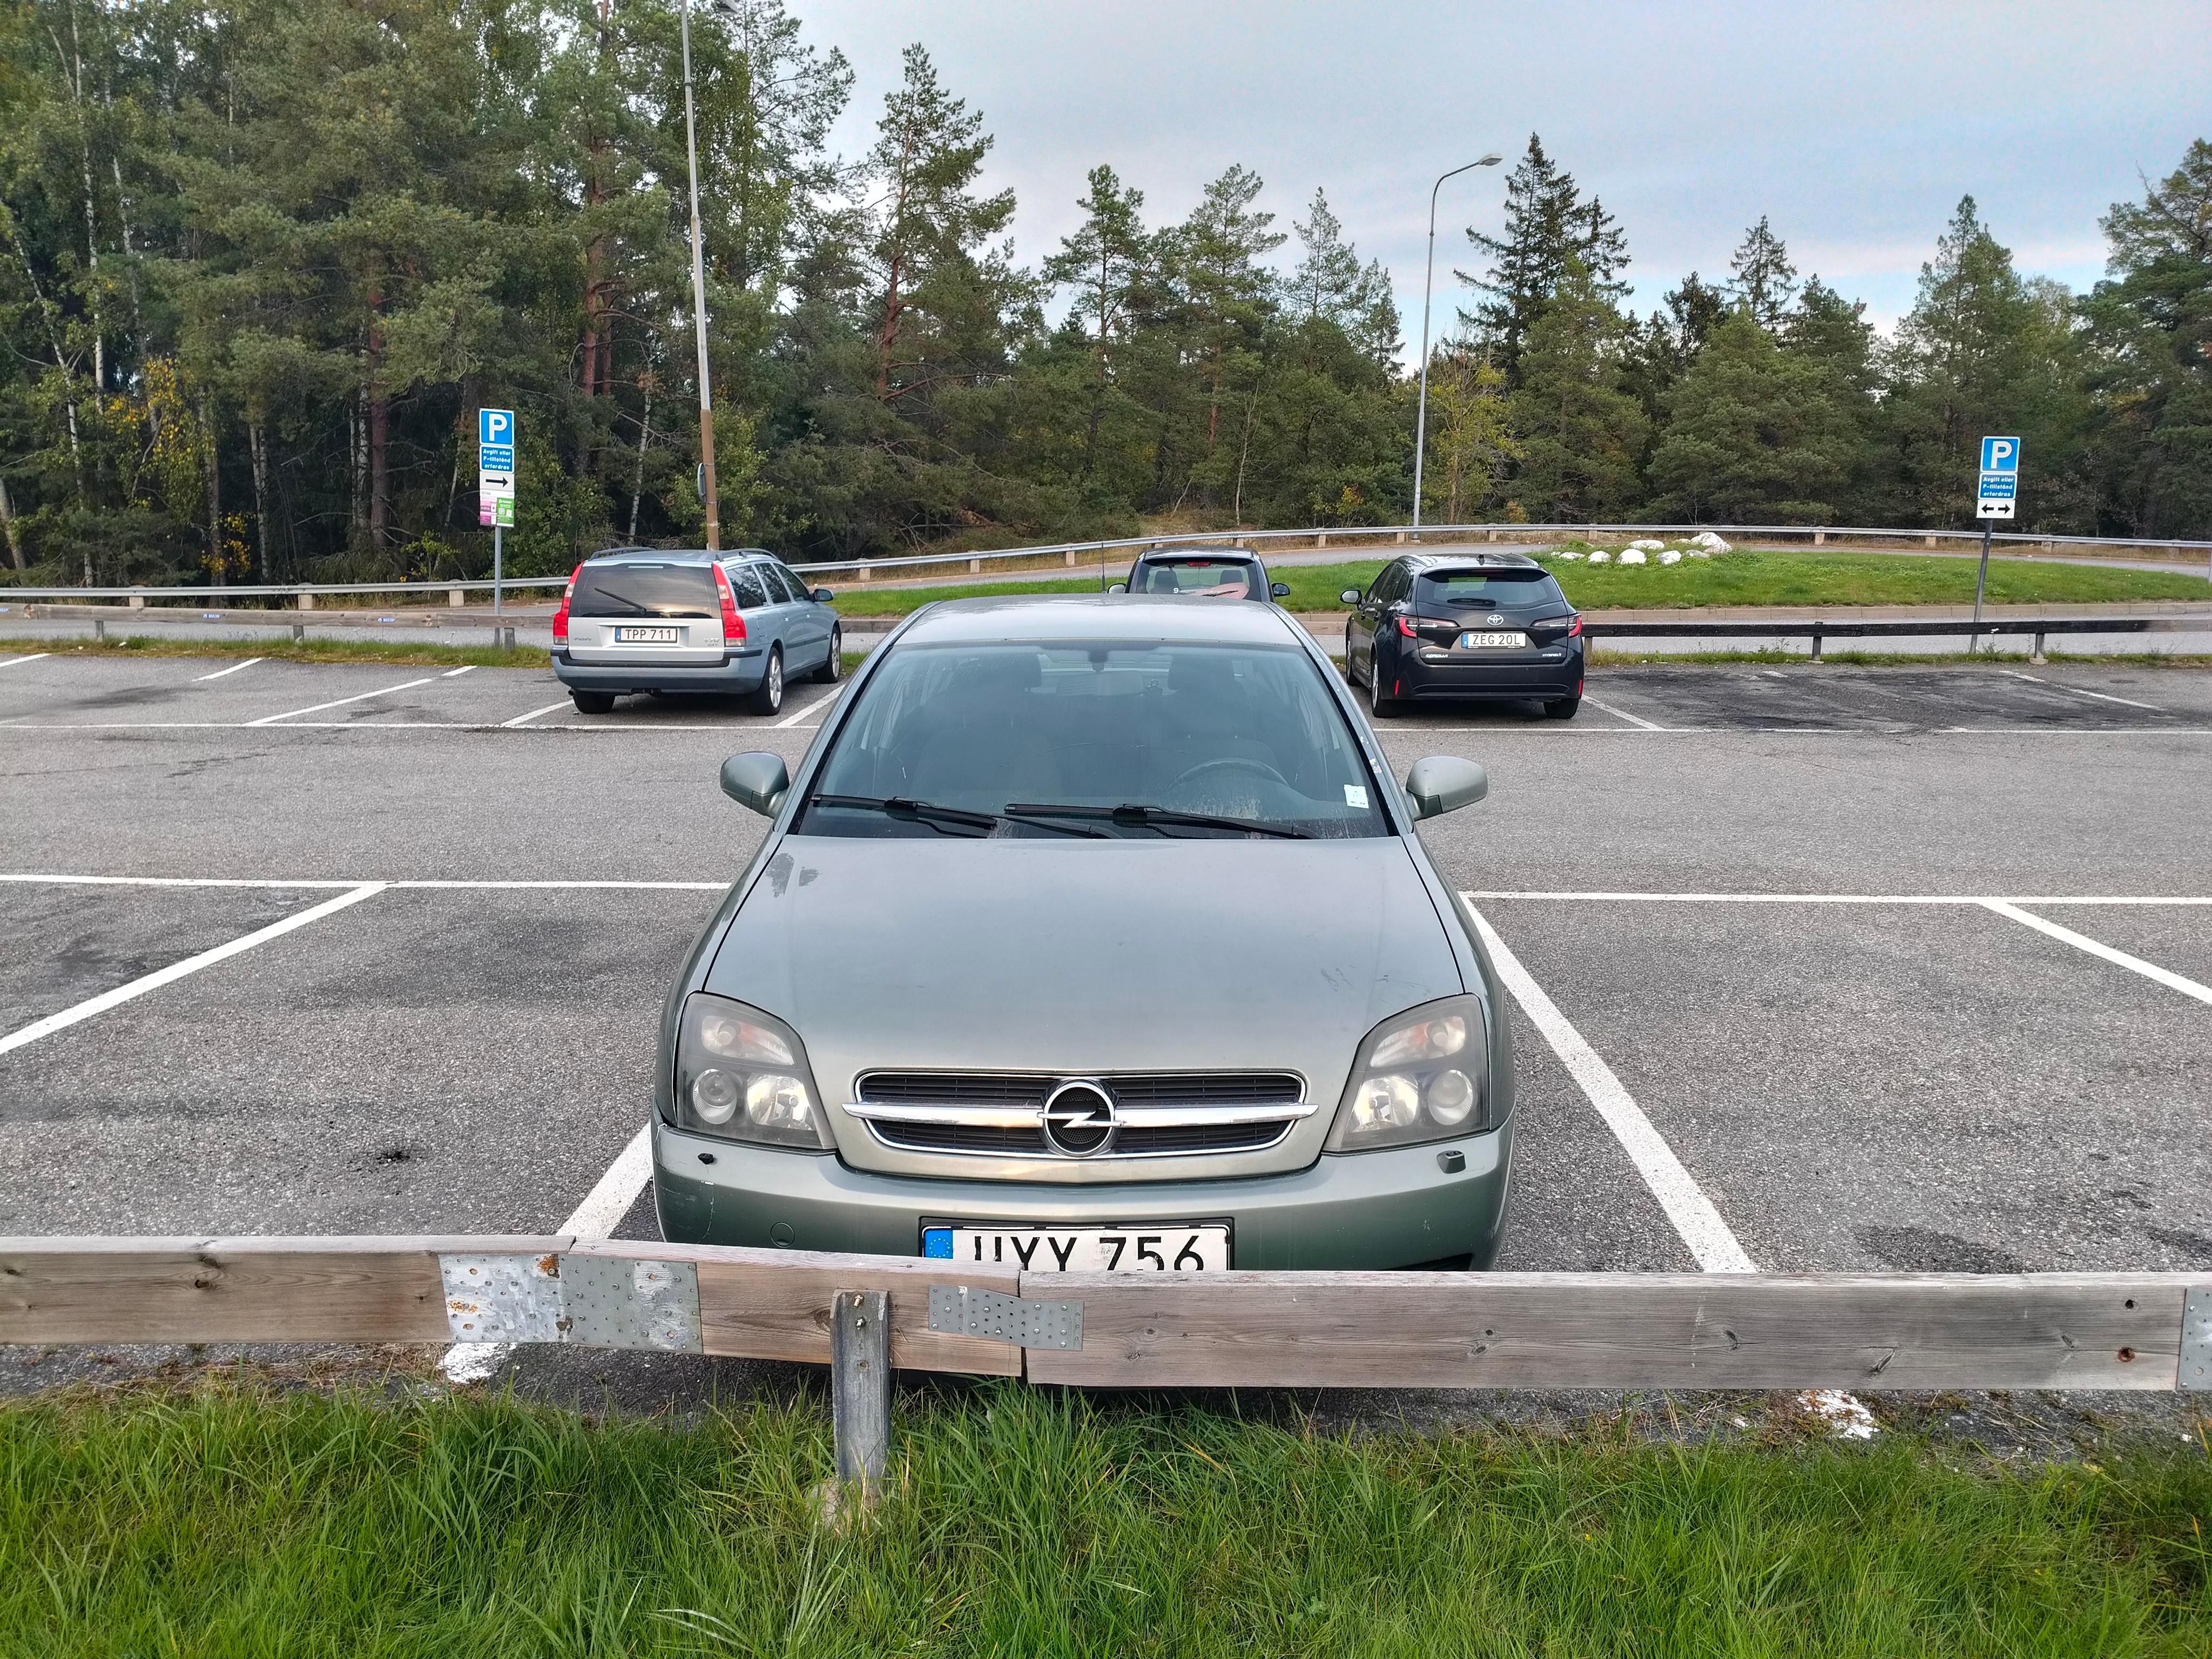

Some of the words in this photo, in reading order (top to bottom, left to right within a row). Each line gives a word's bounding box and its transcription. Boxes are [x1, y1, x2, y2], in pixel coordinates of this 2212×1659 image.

[489, 414, 507, 441] P
[1991, 441, 2012, 469] P
[625, 629, 646, 639] TPP
[650, 629, 671, 639] 711
[1473, 635, 1494, 645] ZEG
[1499, 635, 1520, 645] 20L
[1099, 1235, 1204, 1271] 756
